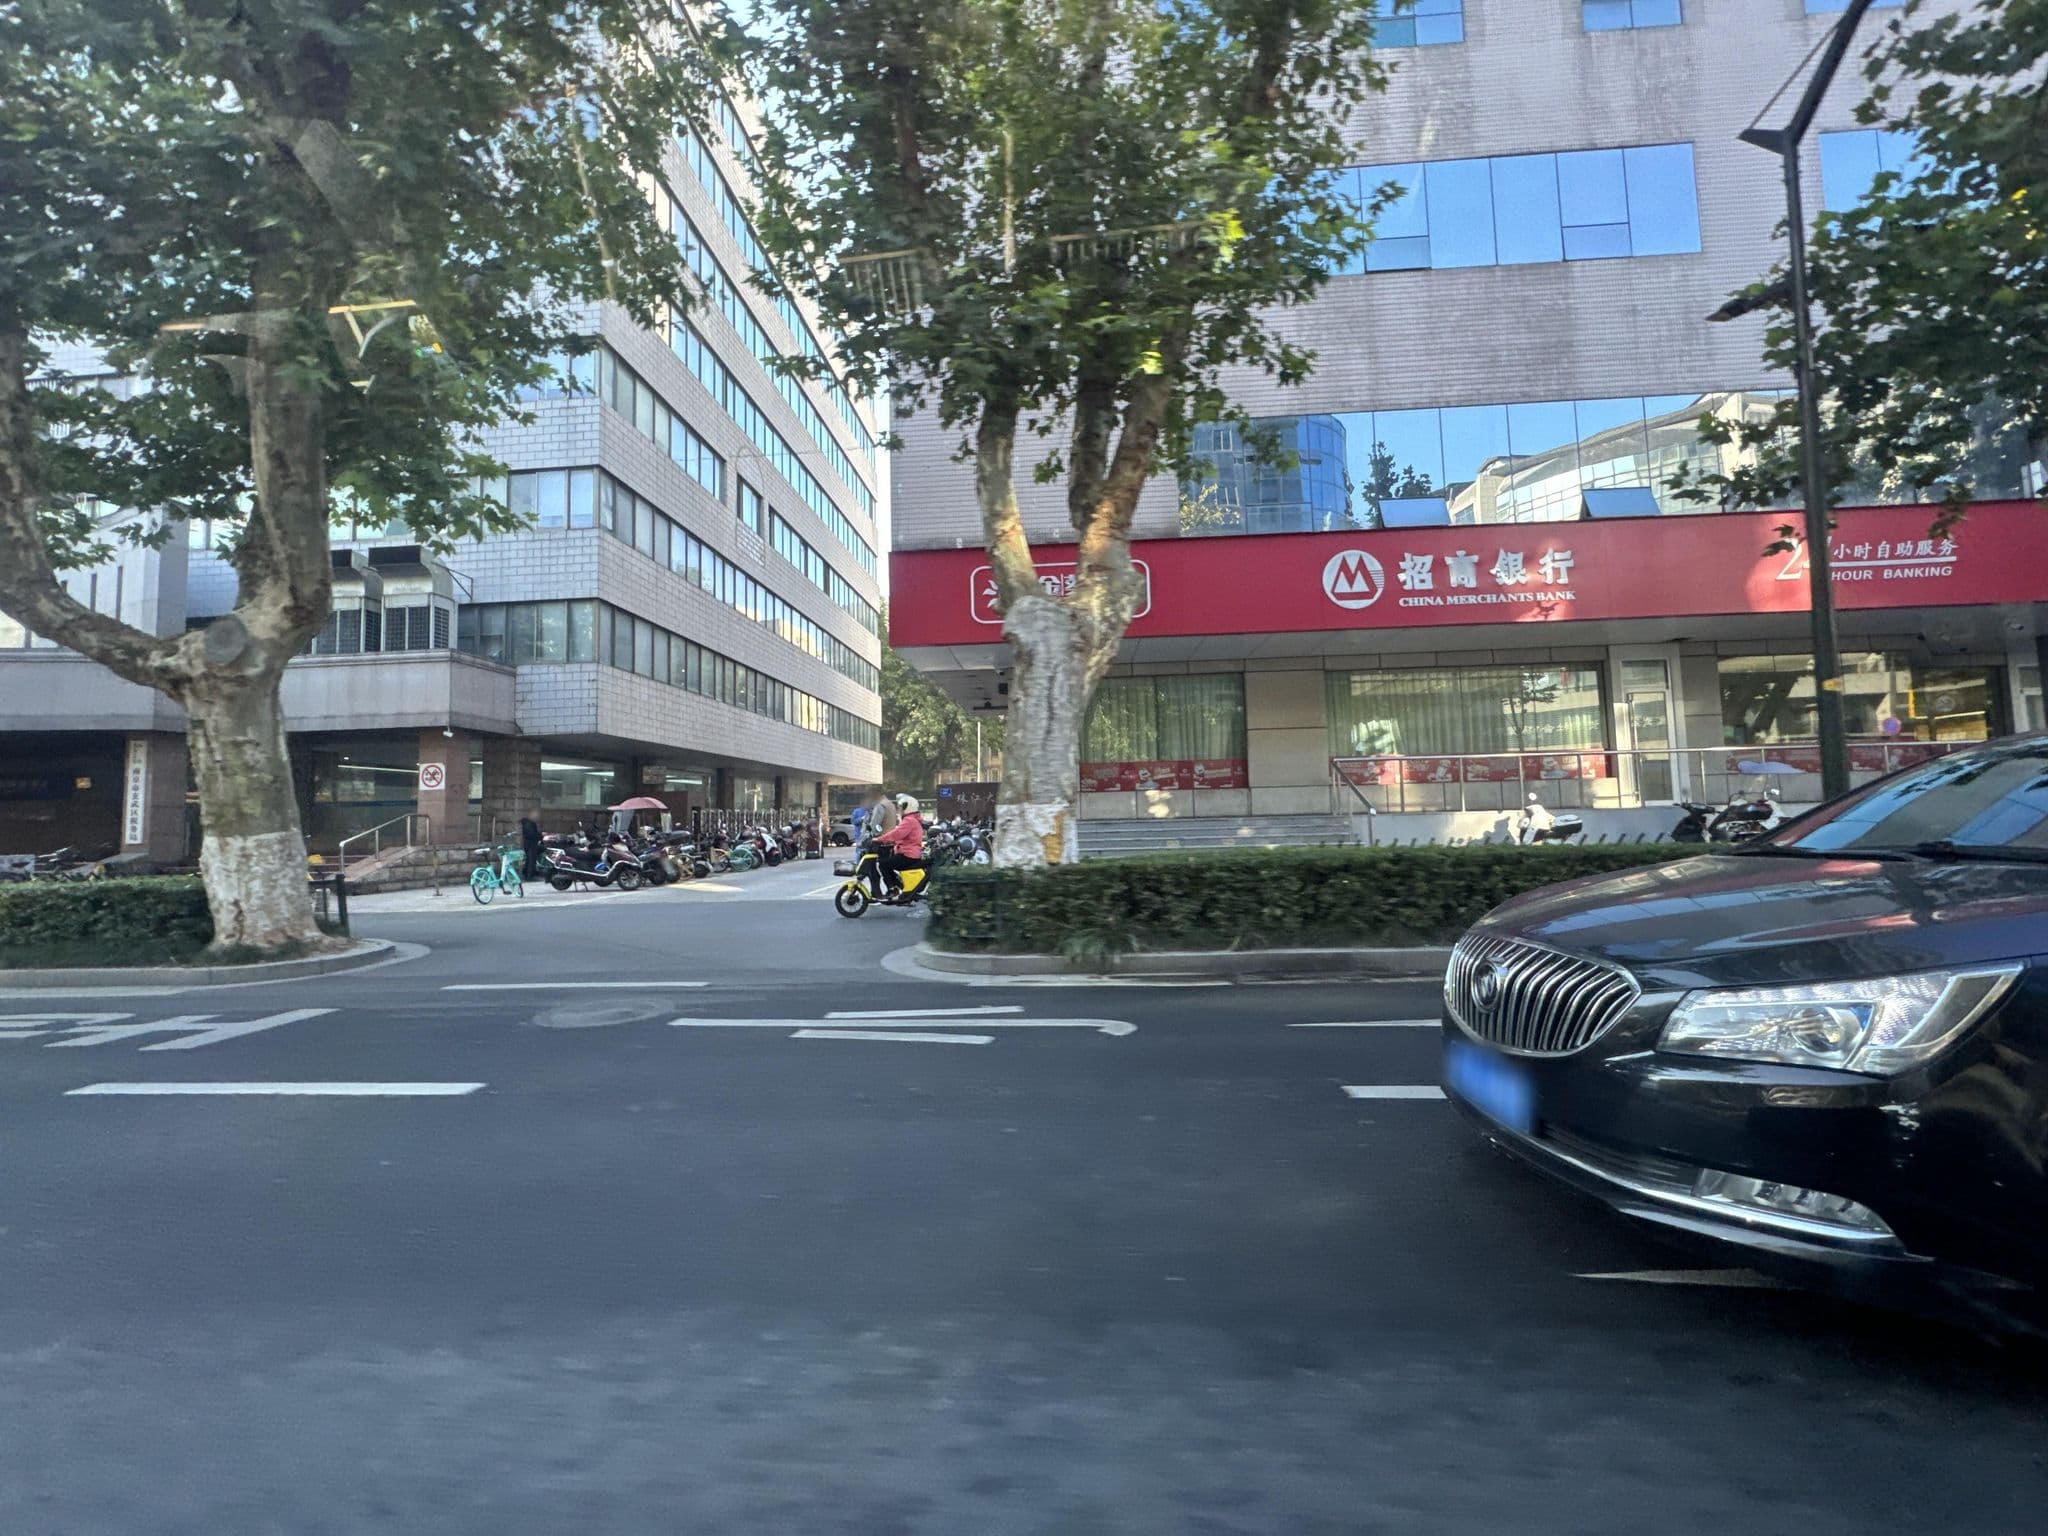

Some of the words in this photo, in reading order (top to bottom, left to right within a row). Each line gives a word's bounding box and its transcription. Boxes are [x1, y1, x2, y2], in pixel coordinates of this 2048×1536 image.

[1833, 538, 1960, 560] 小时自助服务
[1831, 568, 1873, 581] HOUR
[1883, 566, 1953, 579] BANKING
[1398, 595, 1444, 608] CHINA
[1446, 592, 1535, 606] MERCHANTS
[1535, 590, 1576, 602] BANK
